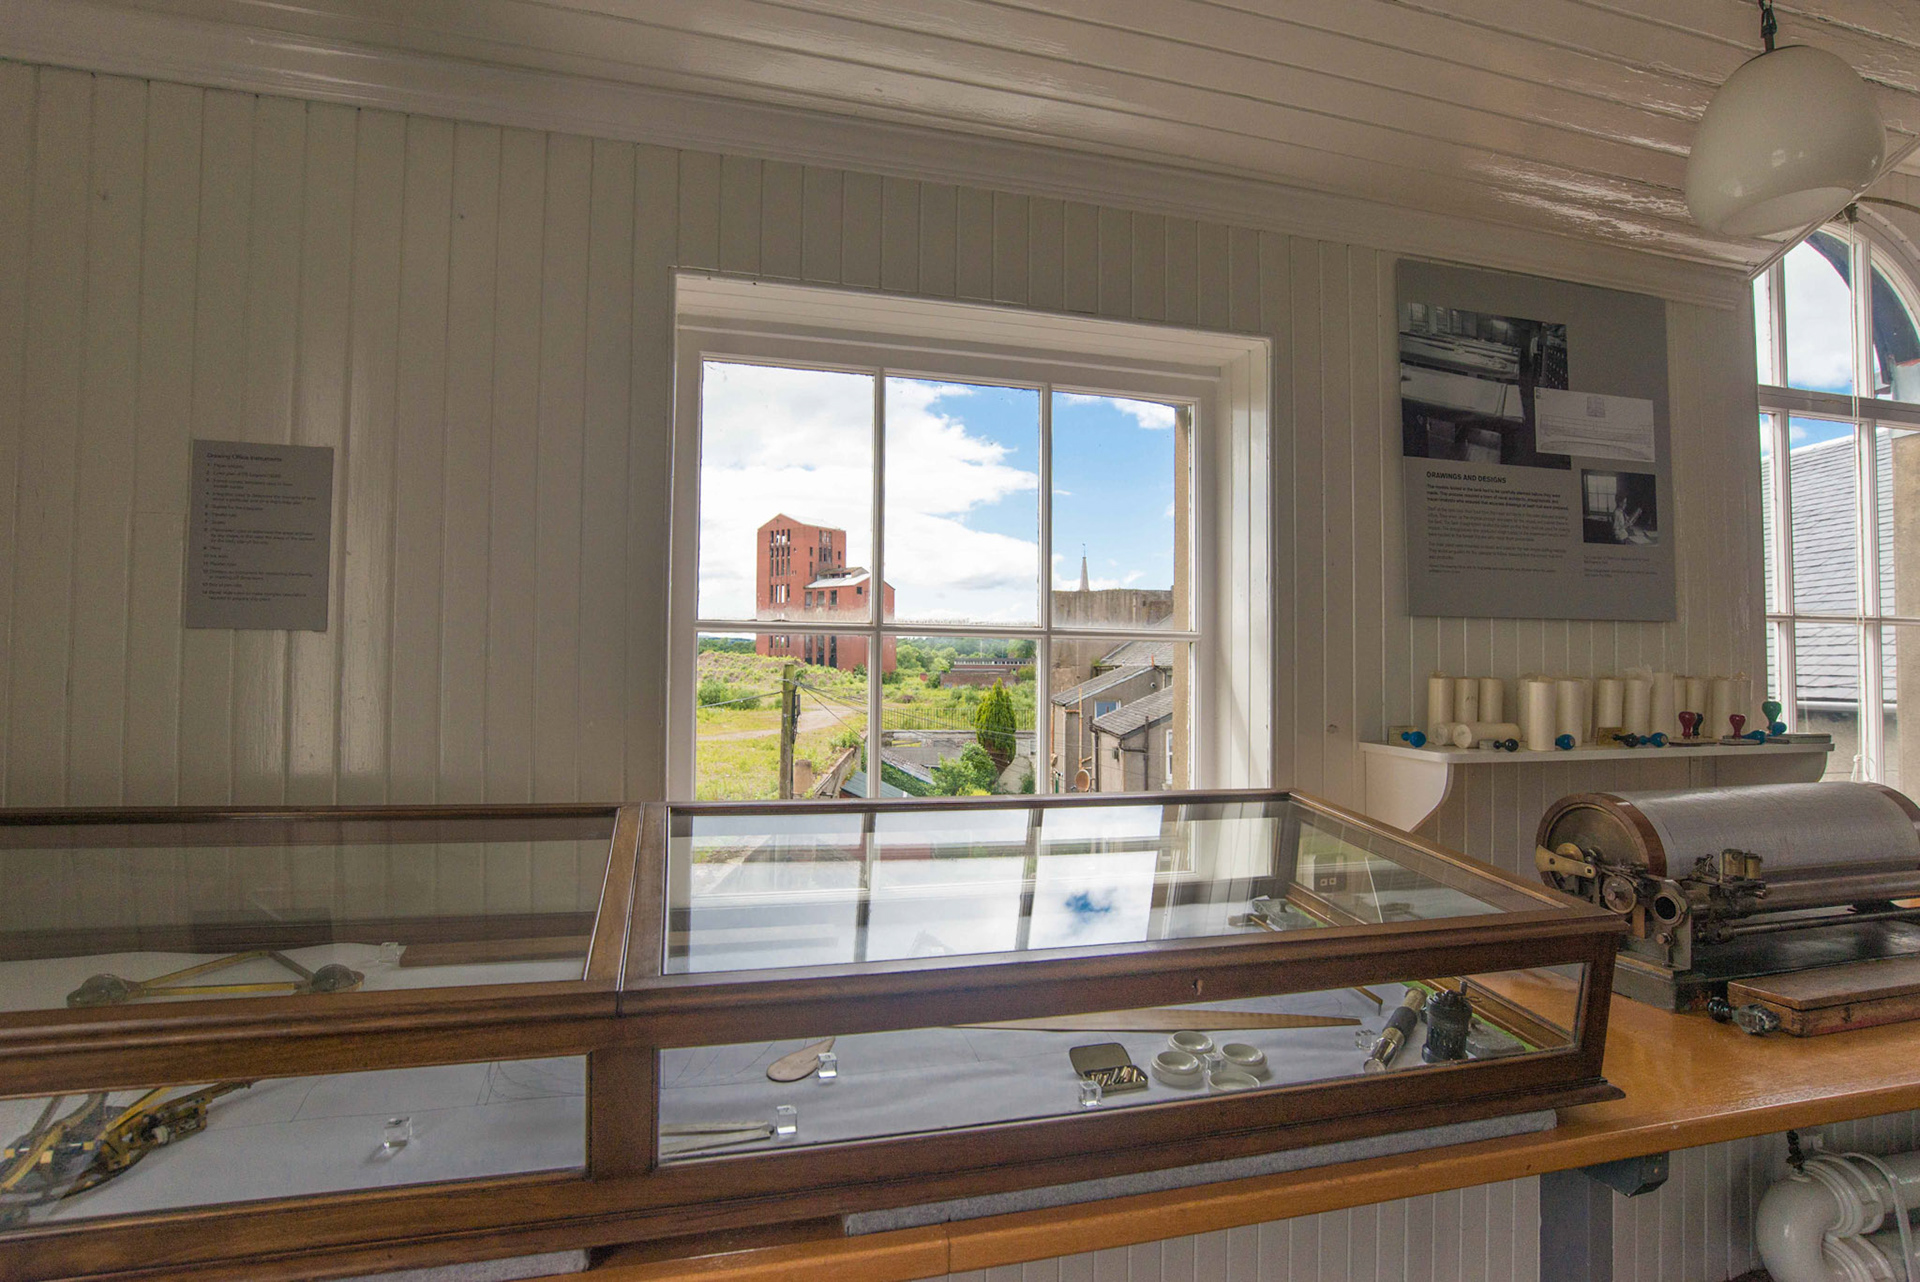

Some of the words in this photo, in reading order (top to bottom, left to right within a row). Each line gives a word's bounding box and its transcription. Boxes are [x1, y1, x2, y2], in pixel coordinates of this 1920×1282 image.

[1426, 471, 1463, 481] DRAWINGS
[1463, 474, 1478, 482] AND
[1478, 475, 1507, 484] DESIGNS
